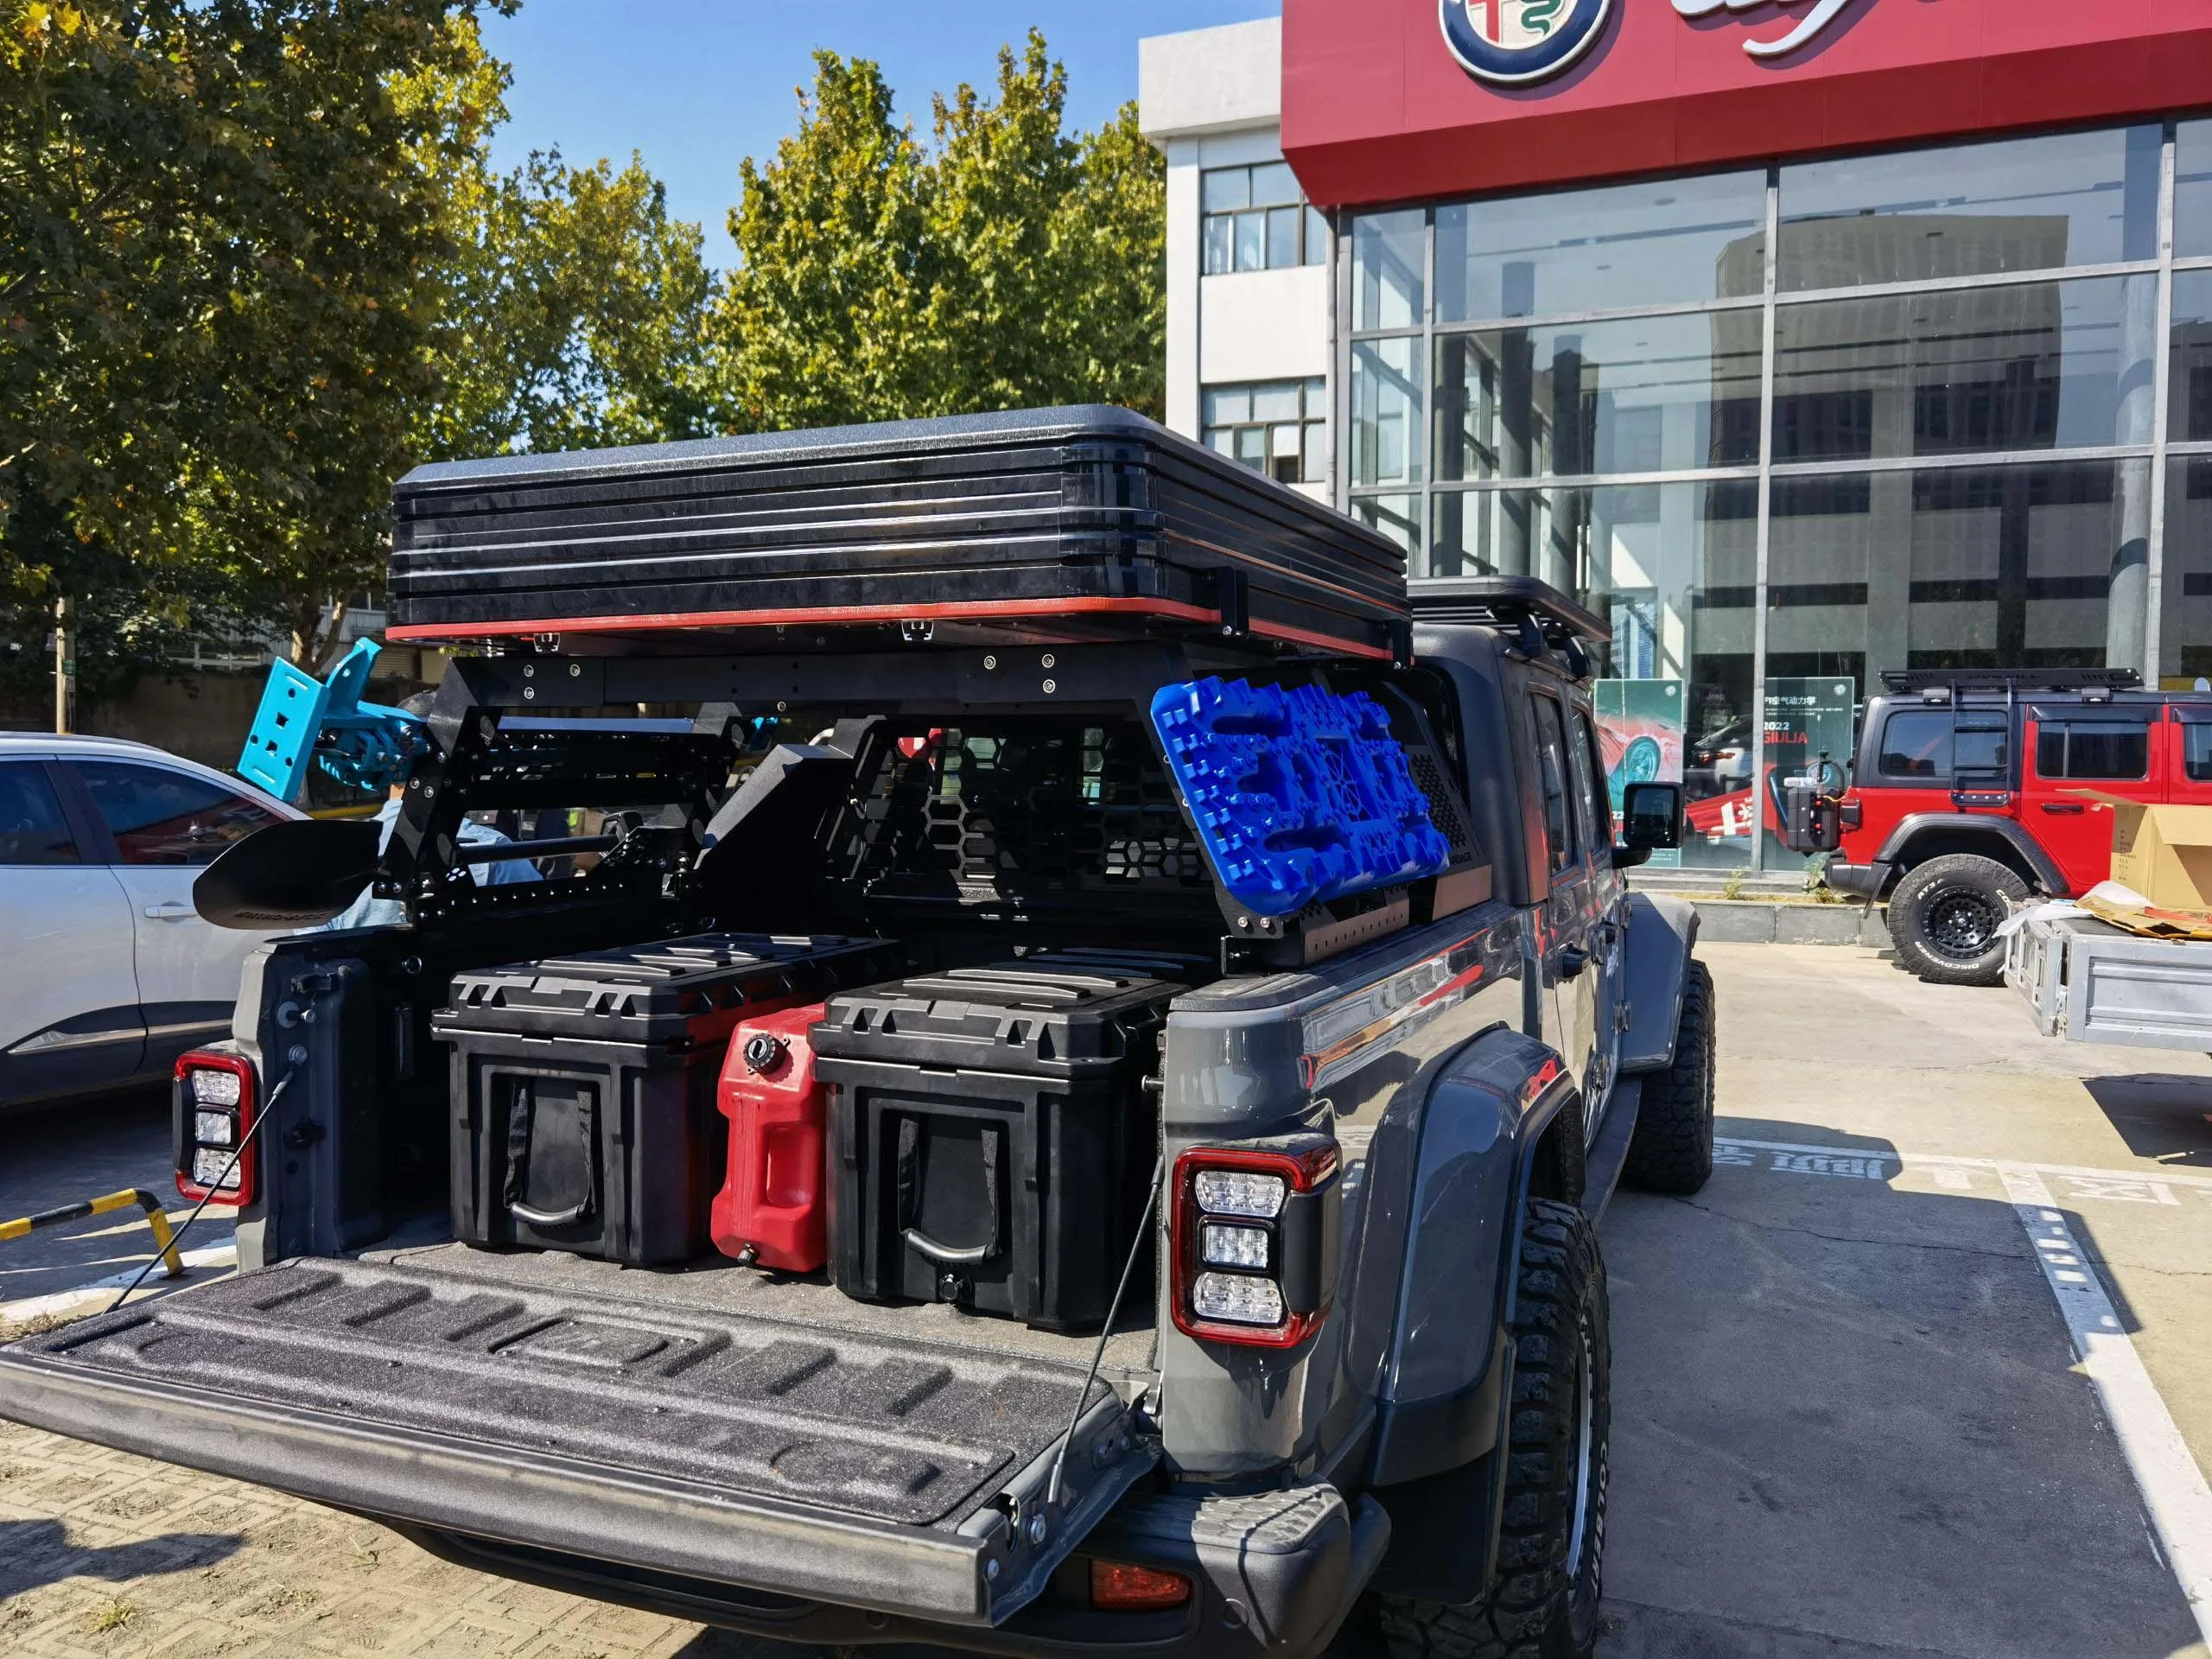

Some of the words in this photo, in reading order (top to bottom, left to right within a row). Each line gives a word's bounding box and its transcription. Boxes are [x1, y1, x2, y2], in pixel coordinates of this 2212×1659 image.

[1764, 721, 1789, 731] 2022
[1764, 732, 1808, 744] GIULIA
[1915, 941, 1980, 969] DISCOVERER
[1591, 1440, 1608, 1599] COLBERT
